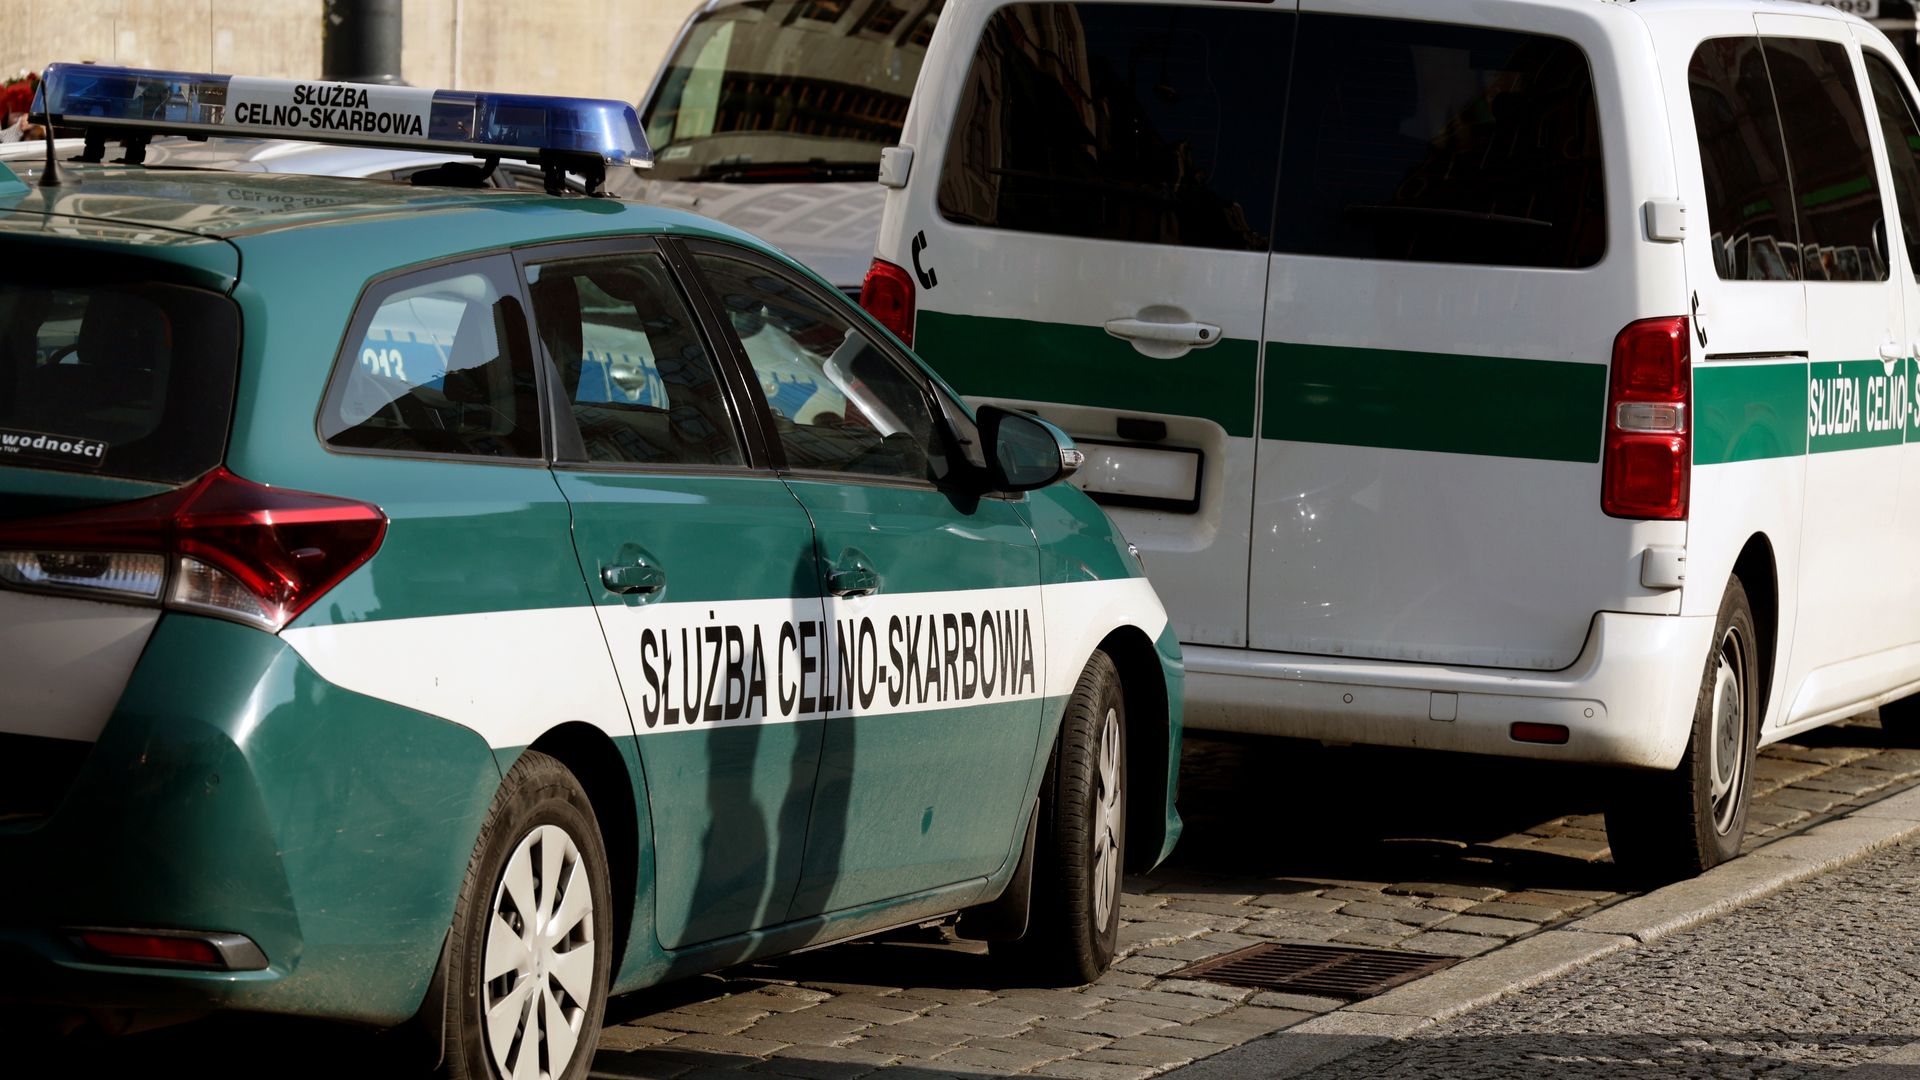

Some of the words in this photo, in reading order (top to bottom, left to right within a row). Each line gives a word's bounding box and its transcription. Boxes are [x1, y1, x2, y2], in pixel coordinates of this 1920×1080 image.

[294, 84, 369, 109] SŁUŻBA
[235, 102, 423, 136] CELNO-SKARBOWA
[1809, 363, 1860, 437] SŁUŻBA
[0, 433, 104, 458] wodności
[640, 610, 768, 728] SŁUŻBA
[777, 608, 1036, 717] CELNO-SKARBOWA
